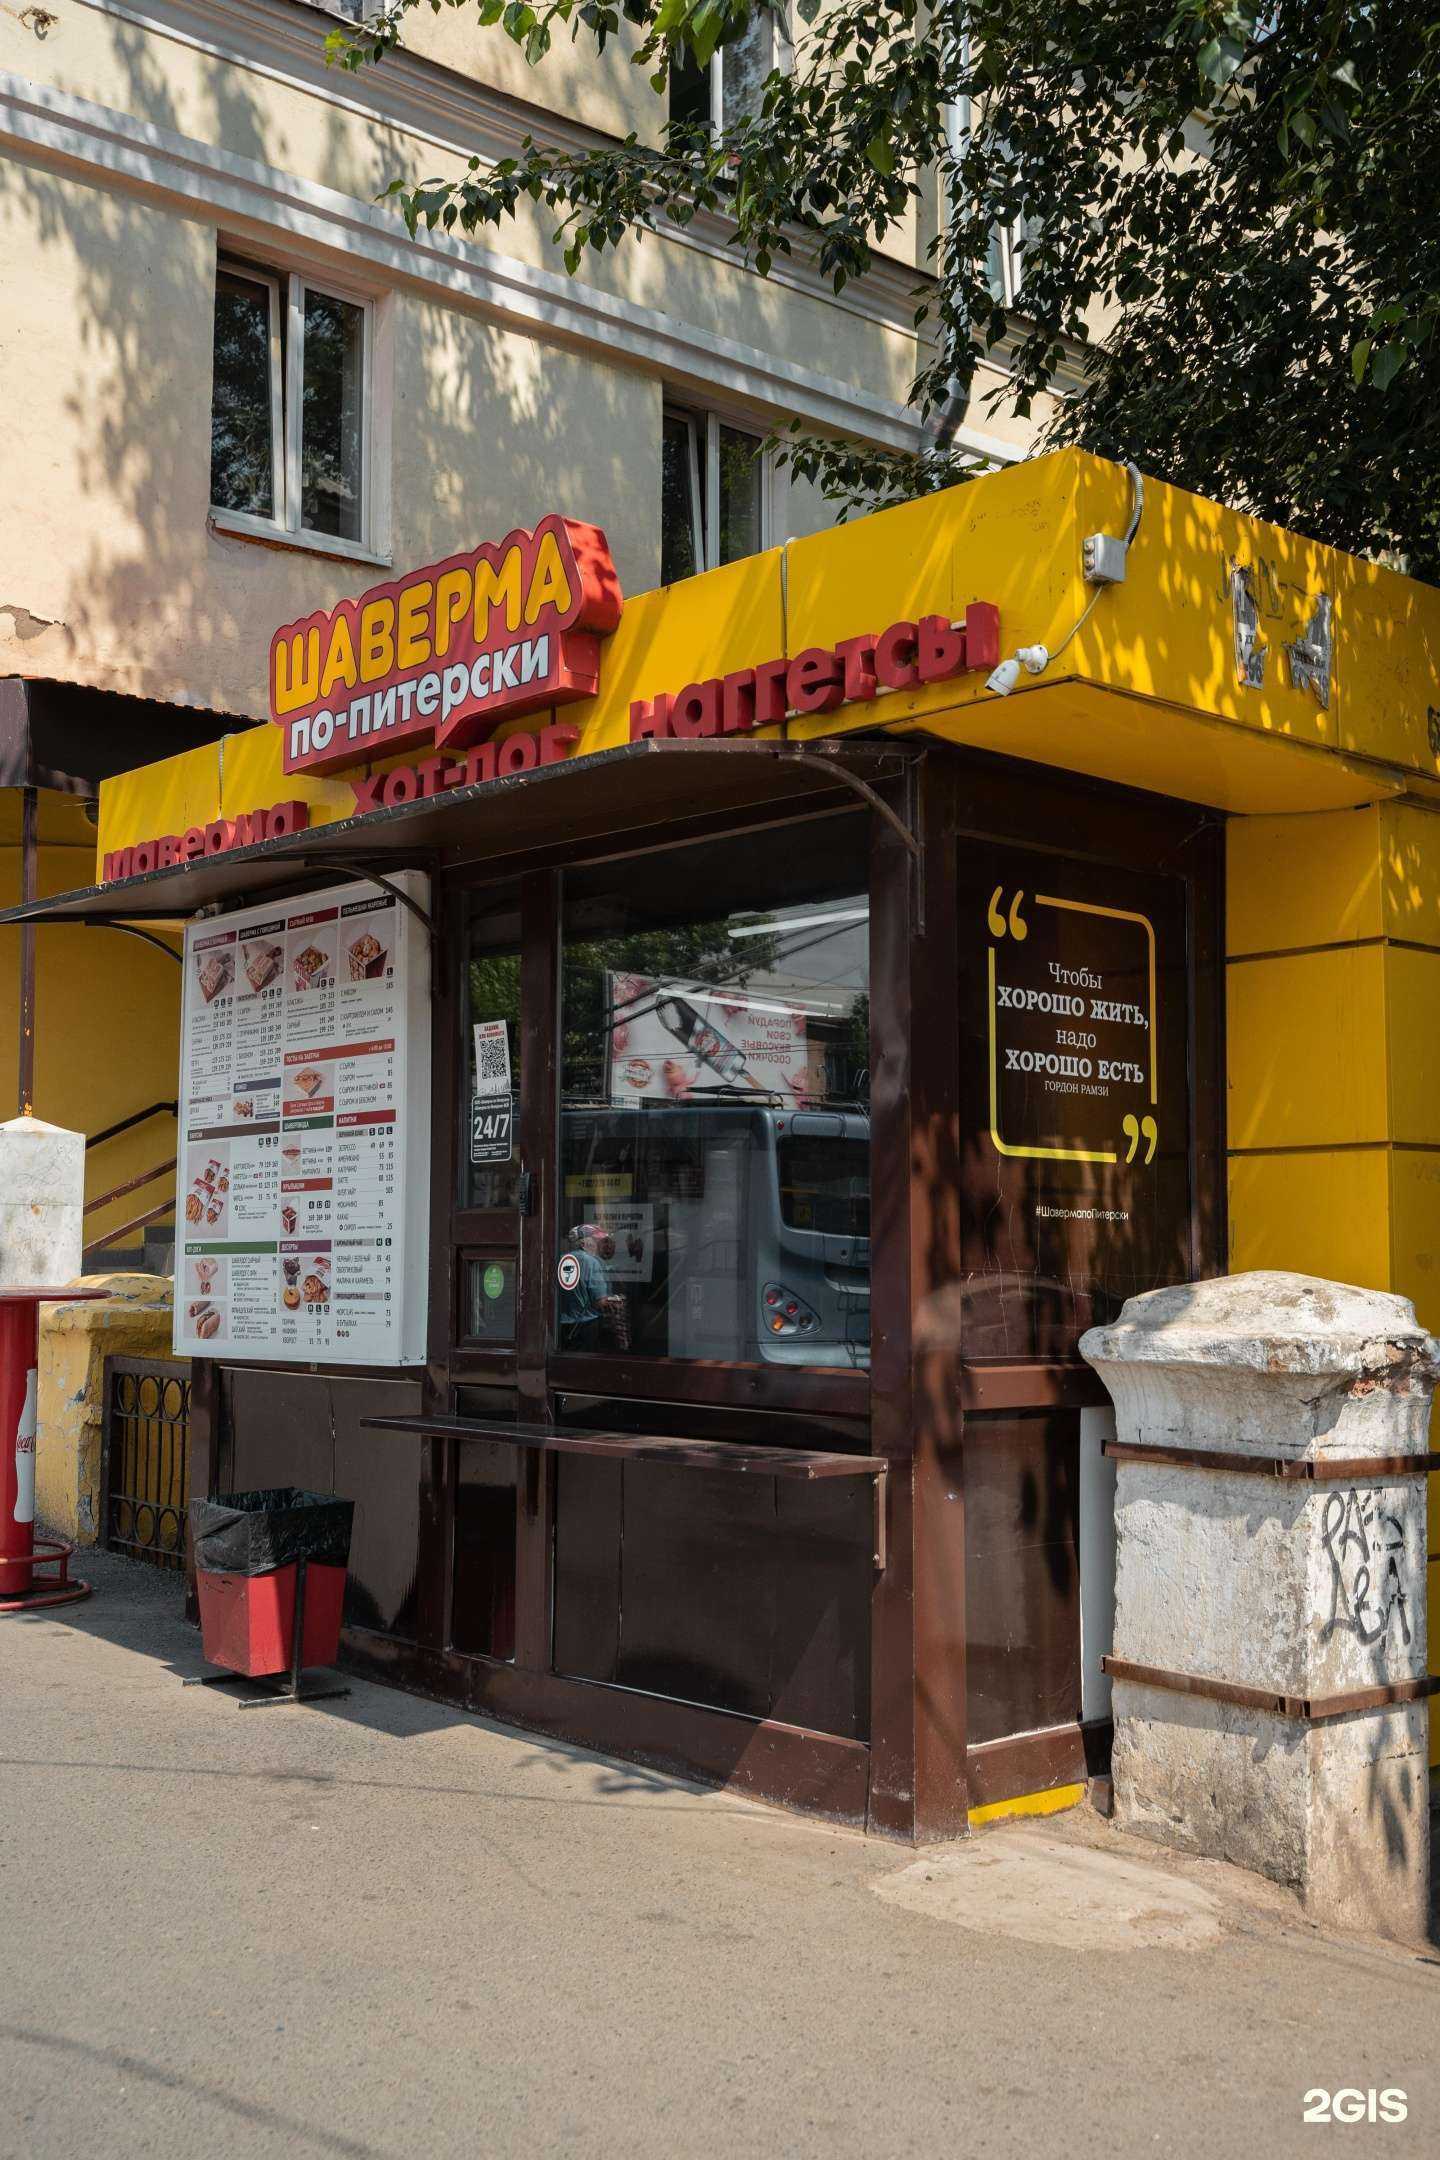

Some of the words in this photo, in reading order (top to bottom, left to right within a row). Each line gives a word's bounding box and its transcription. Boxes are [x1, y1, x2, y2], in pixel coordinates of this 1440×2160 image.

[274, 530, 572, 717] ШАВЕРМА
[629, 601, 999, 740] наггетсы
[103, 800, 307, 883] шаверма
[1048, 962, 1103, 989] Чтобы
[998, 985, 1084, 1017] ХОРОШО
[1090, 999, 1149, 1029] ЖИТЬ,
[1056, 1029, 1096, 1050] надо
[1005, 1049, 1092, 1078] ХОРОШО
[1098, 1060, 1144, 1084] ЕСТЬ
[1045, 1080, 1078, 1094] ГОРДОН
[1081, 1083, 1109, 1097] РАМЗИ
[473, 1114, 510, 1140] 24/7
